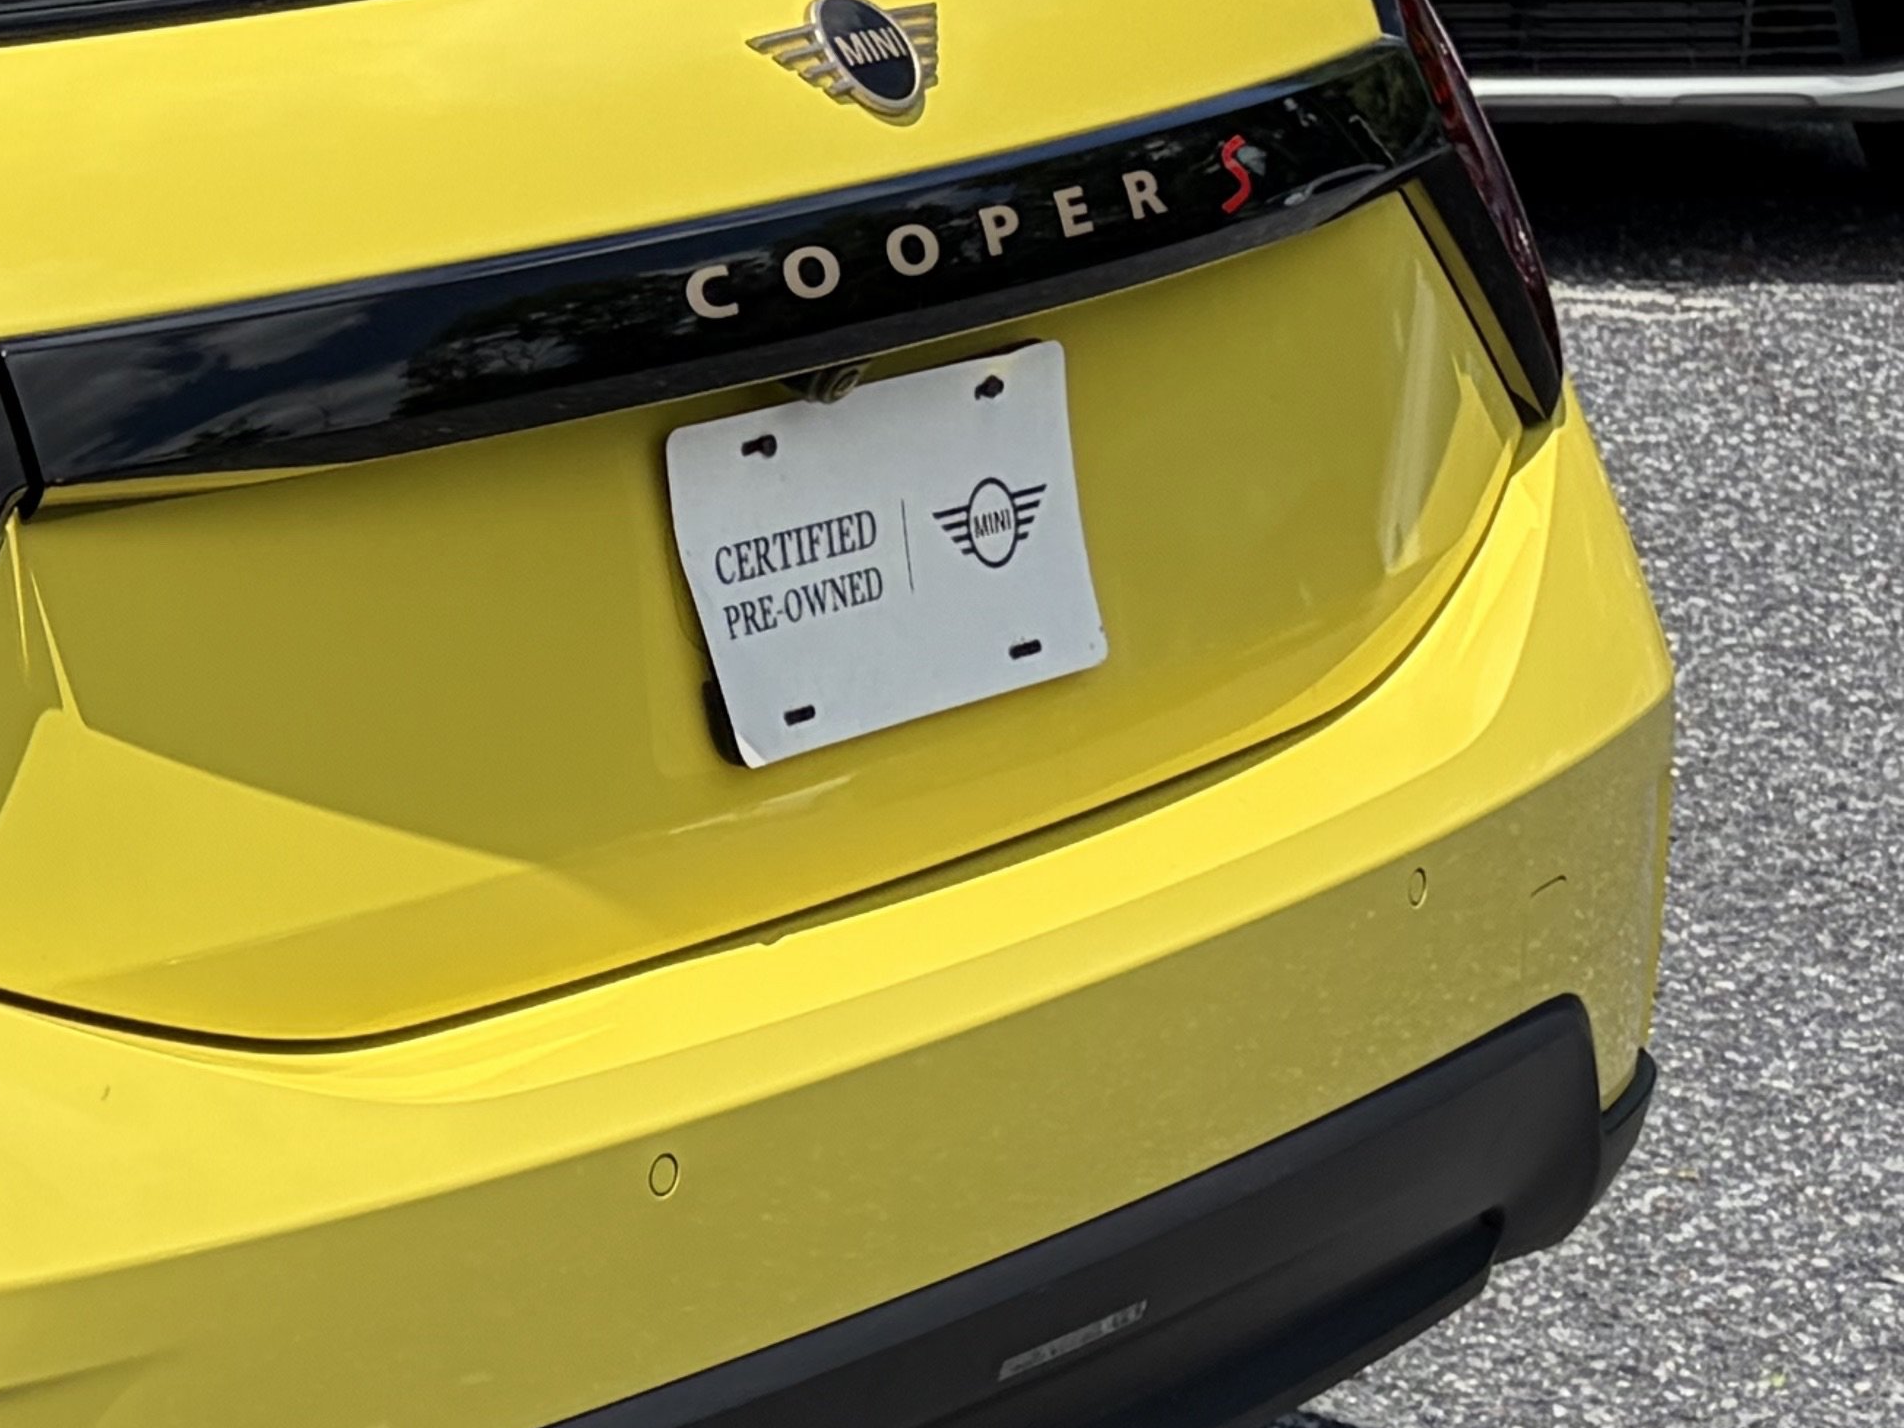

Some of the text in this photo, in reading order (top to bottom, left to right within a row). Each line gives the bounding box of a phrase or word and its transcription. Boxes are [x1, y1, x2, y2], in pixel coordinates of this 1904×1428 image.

[833, 25, 908, 67] MINI
[684, 133, 1255, 319] COOPER S
[714, 509, 878, 585] CERTIFIED
[973, 508, 1012, 539] MINI
[723, 566, 884, 641] PRE-OWNED
